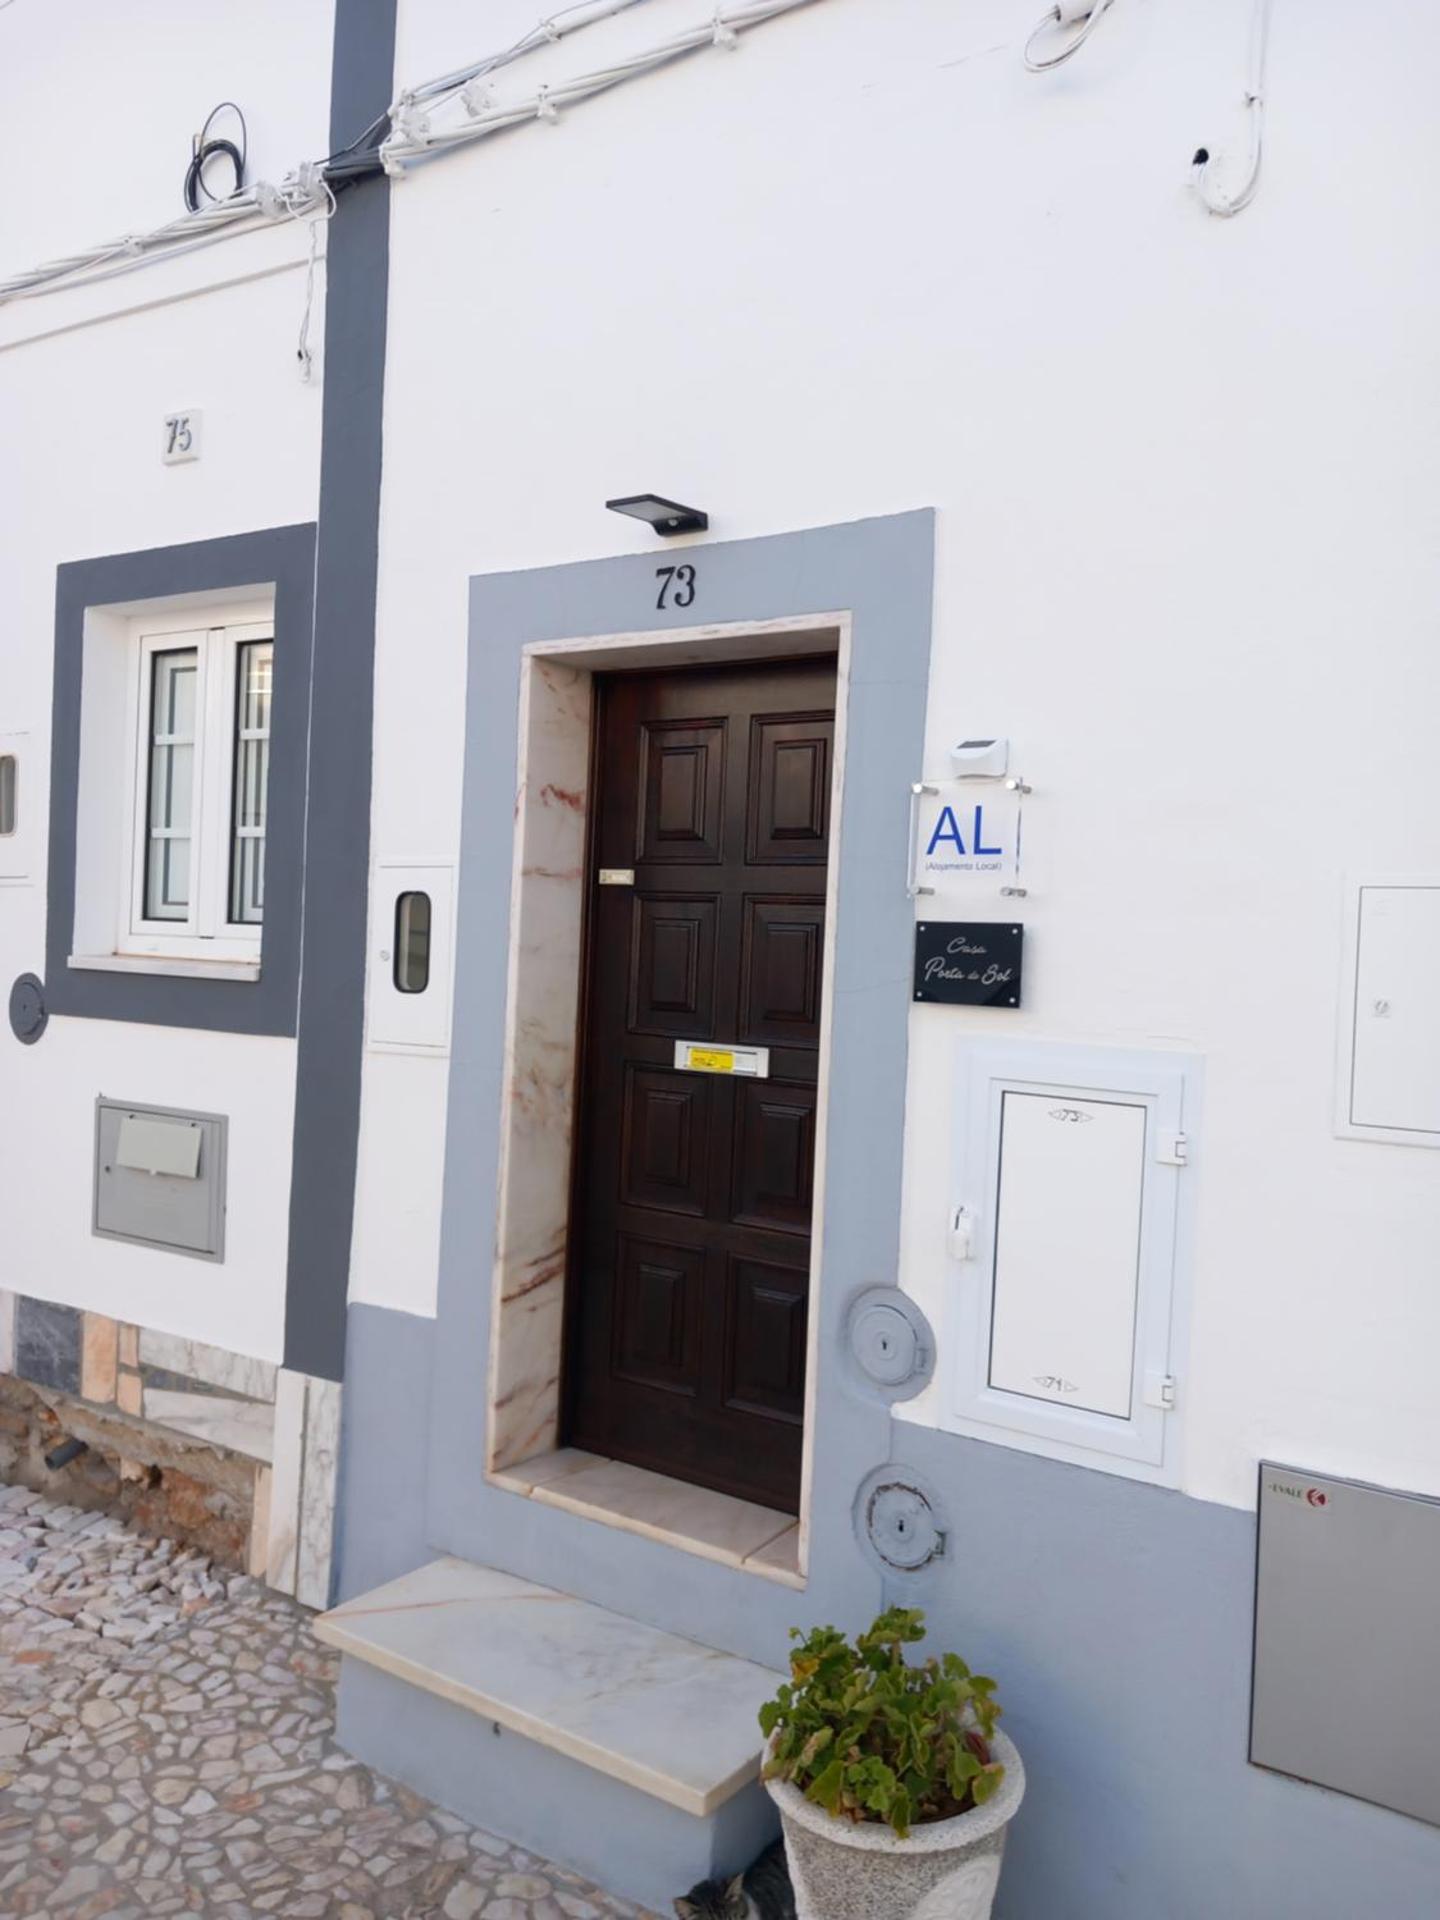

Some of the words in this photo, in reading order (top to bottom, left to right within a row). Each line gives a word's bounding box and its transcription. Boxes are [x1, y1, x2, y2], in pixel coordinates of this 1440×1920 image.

[165, 417, 192, 454] 75
[656, 564, 696, 610] 73
[926, 805, 1002, 855] AL
[975, 862, 1002, 871] Local)
[946, 936, 987, 954] Casa
[981, 963, 1012, 985] Sol
